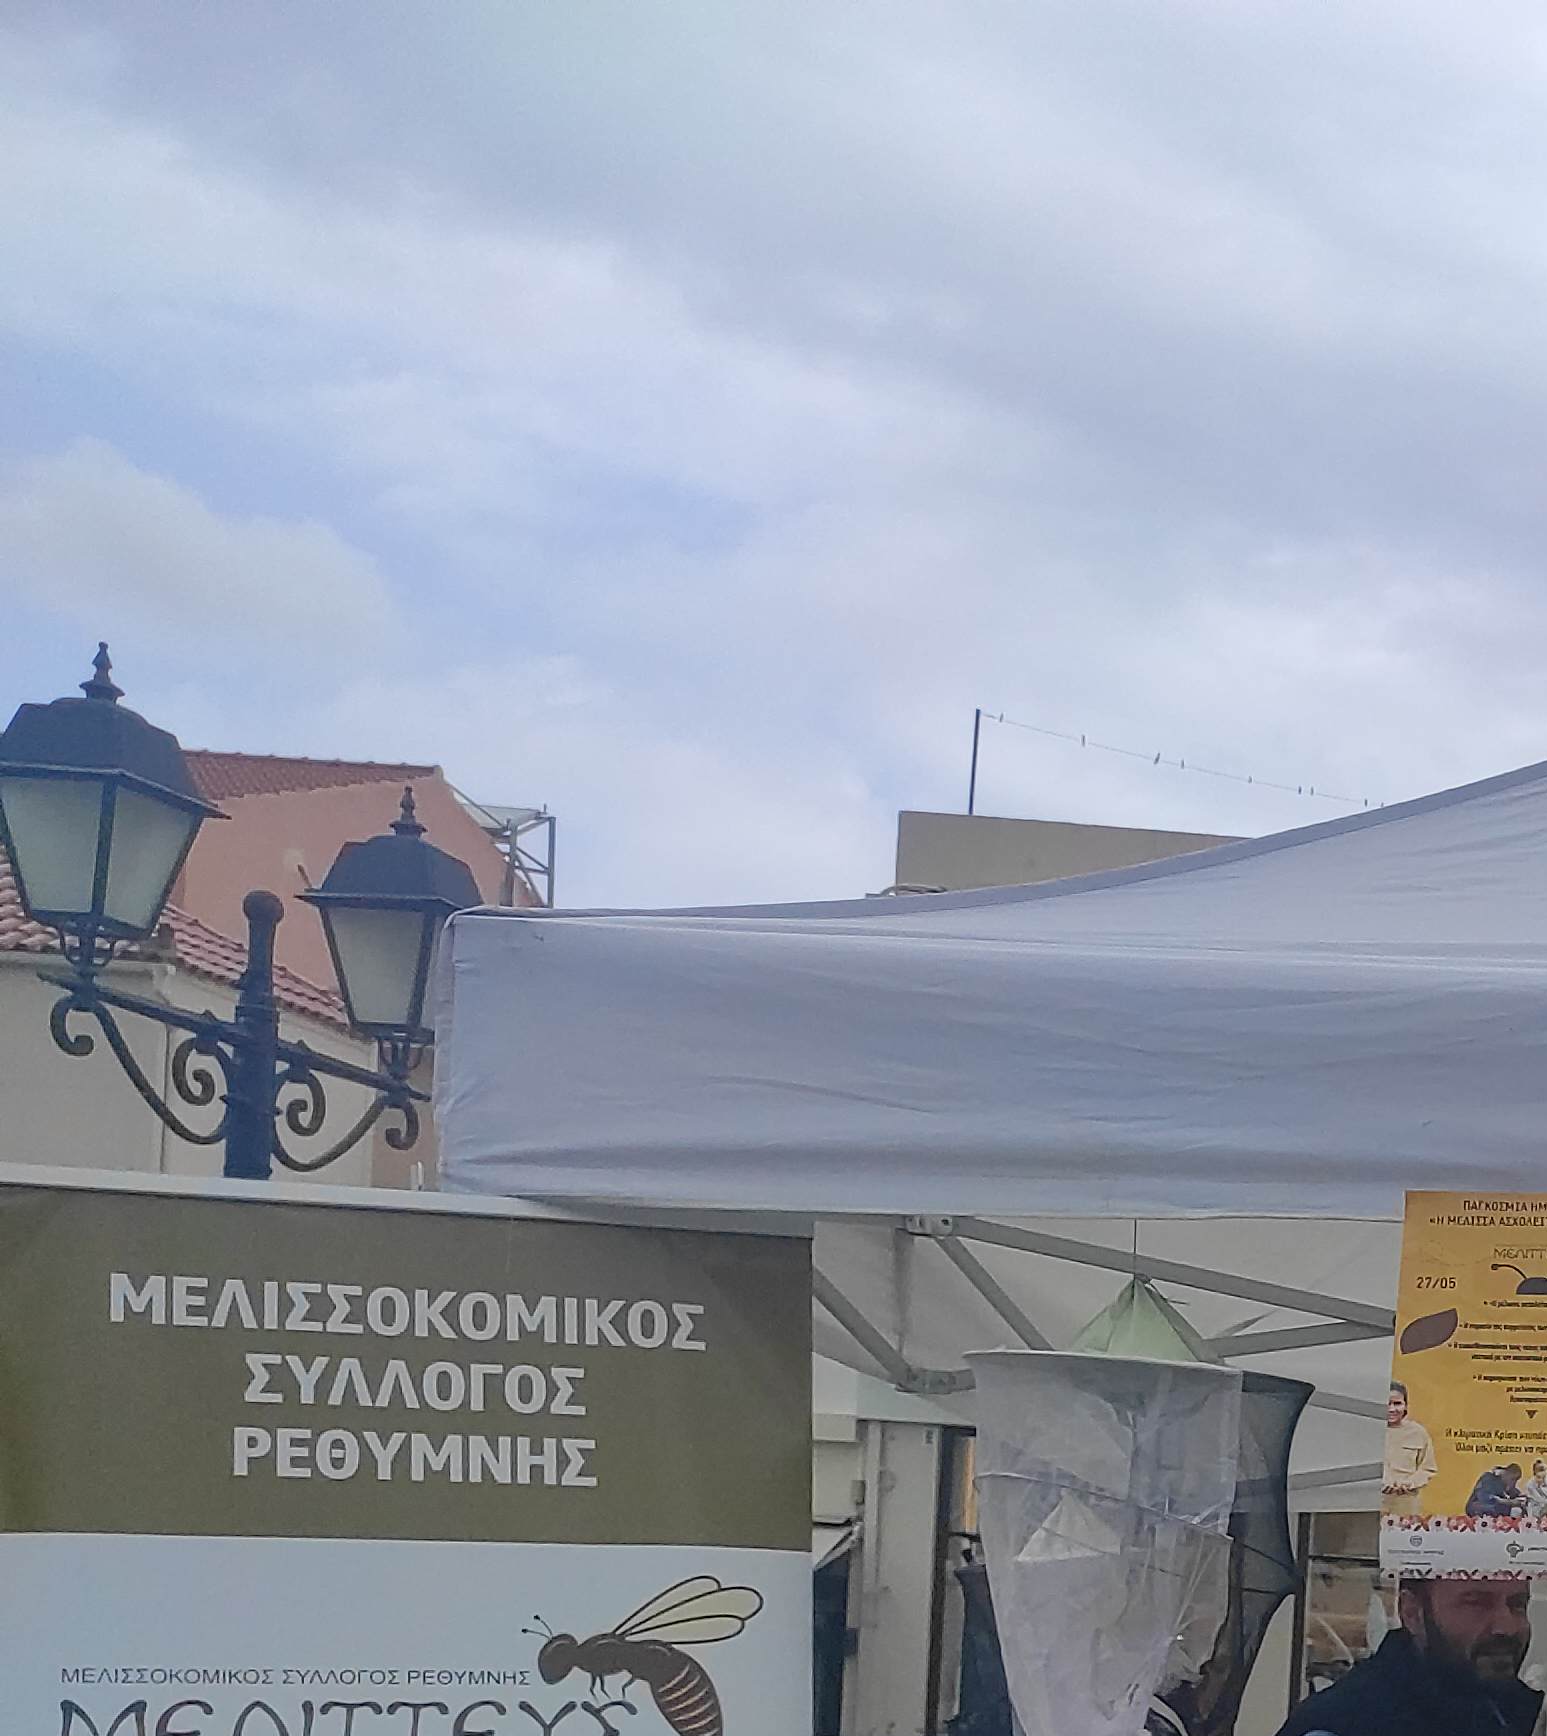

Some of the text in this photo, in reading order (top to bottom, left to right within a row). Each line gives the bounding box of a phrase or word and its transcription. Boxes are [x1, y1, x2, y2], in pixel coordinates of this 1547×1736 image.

[1463, 1200, 1528, 1212] ΠΑΓΚΟΣΜΙΑ
[1447, 1215, 1496, 1227] ΜΕΛΙΣΣΑ
[1416, 1276, 1457, 1290] 27/05
[109, 1271, 707, 1352] ΜΕΛΙΣΣΟΚΟΜΙΚΟΣ
[244, 1352, 588, 1417] ΣΥΛΛΟΓΟΣ
[232, 1427, 599, 1488] ΡΕΘΥΜΝΗΣ
[60, 1666, 532, 1688] ΜΕΛΙΣΣΟΚΟΜΙΚΟΣ ΣΥΛΛΟΓΟΣ ΡΕΘΥΜΝΗΣ
